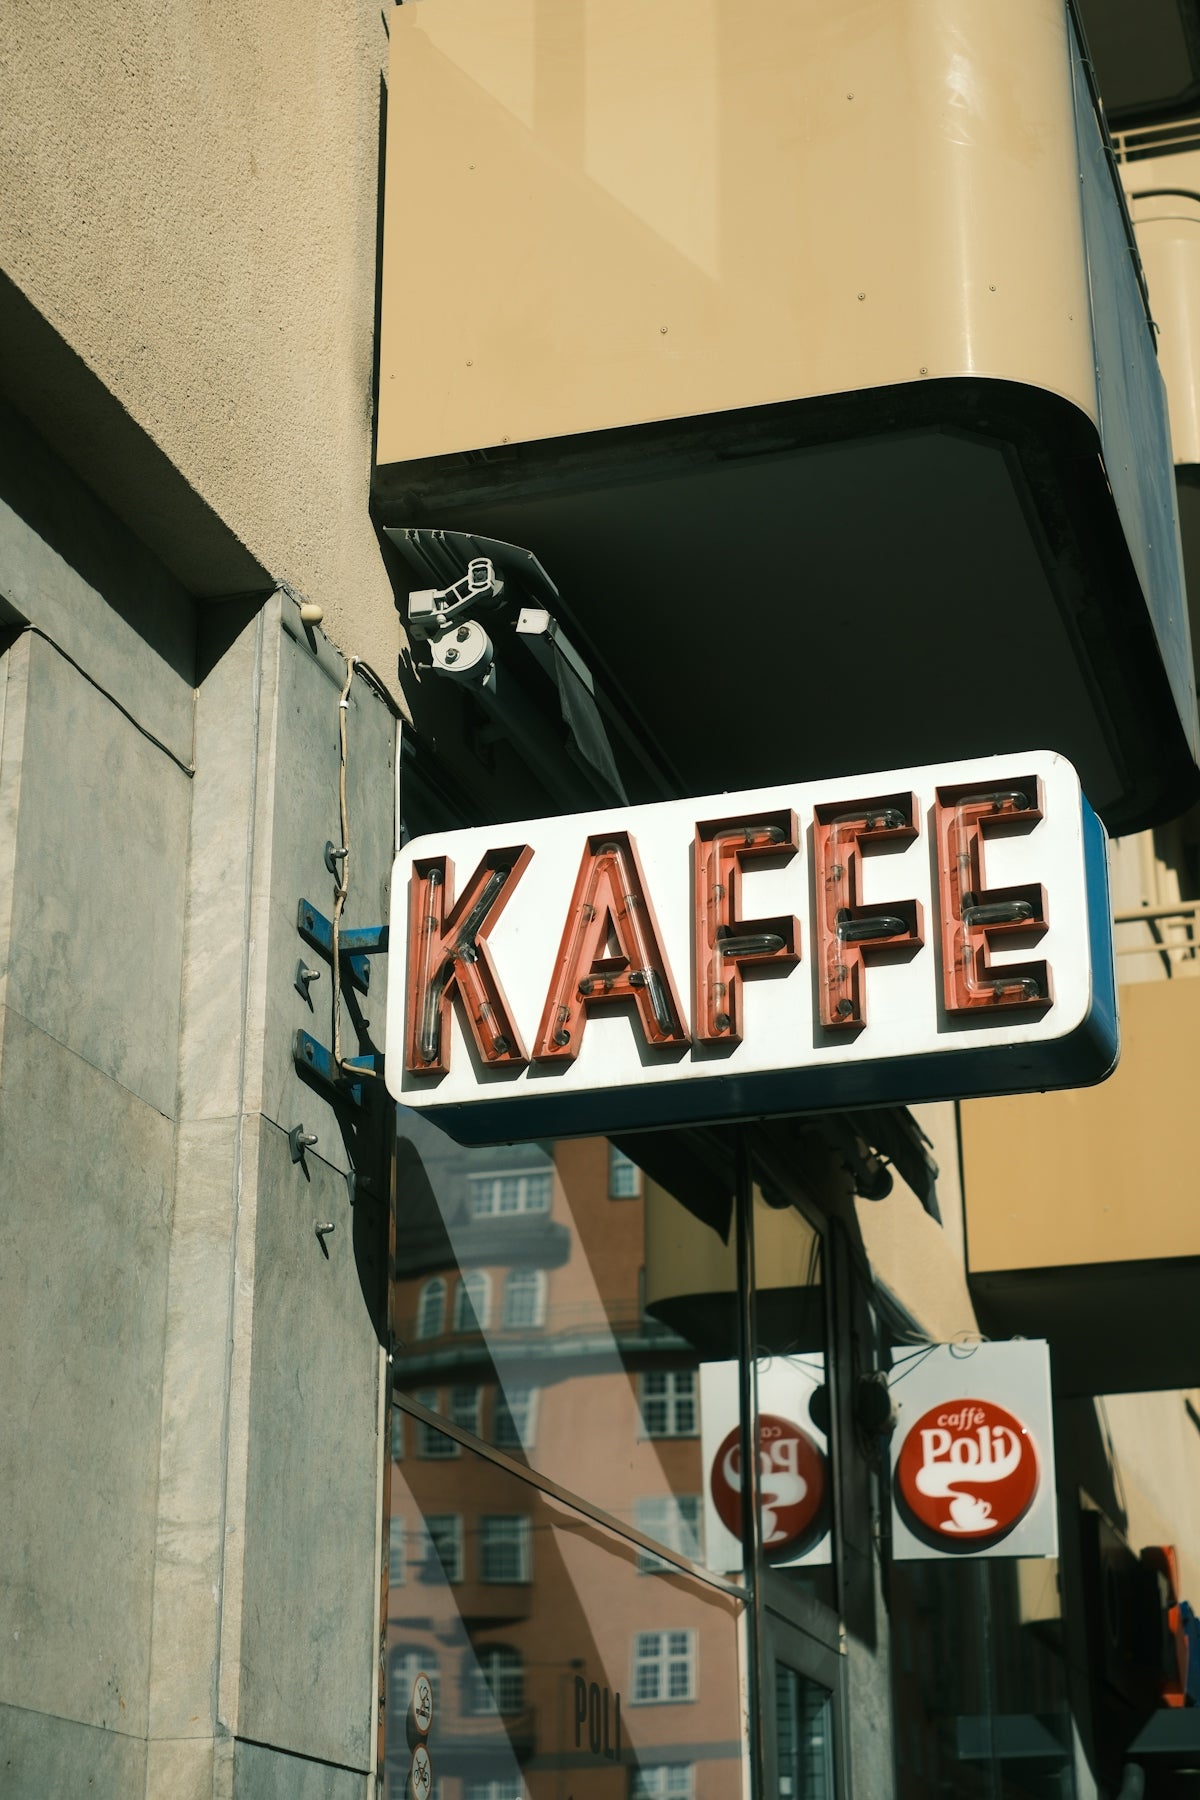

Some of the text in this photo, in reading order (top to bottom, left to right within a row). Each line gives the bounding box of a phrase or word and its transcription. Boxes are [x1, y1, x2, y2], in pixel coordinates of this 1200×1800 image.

[405, 775, 1053, 1076] KAFFE
[920, 1425, 1022, 1466] Poli
[574, 1674, 620, 1762] POLI
